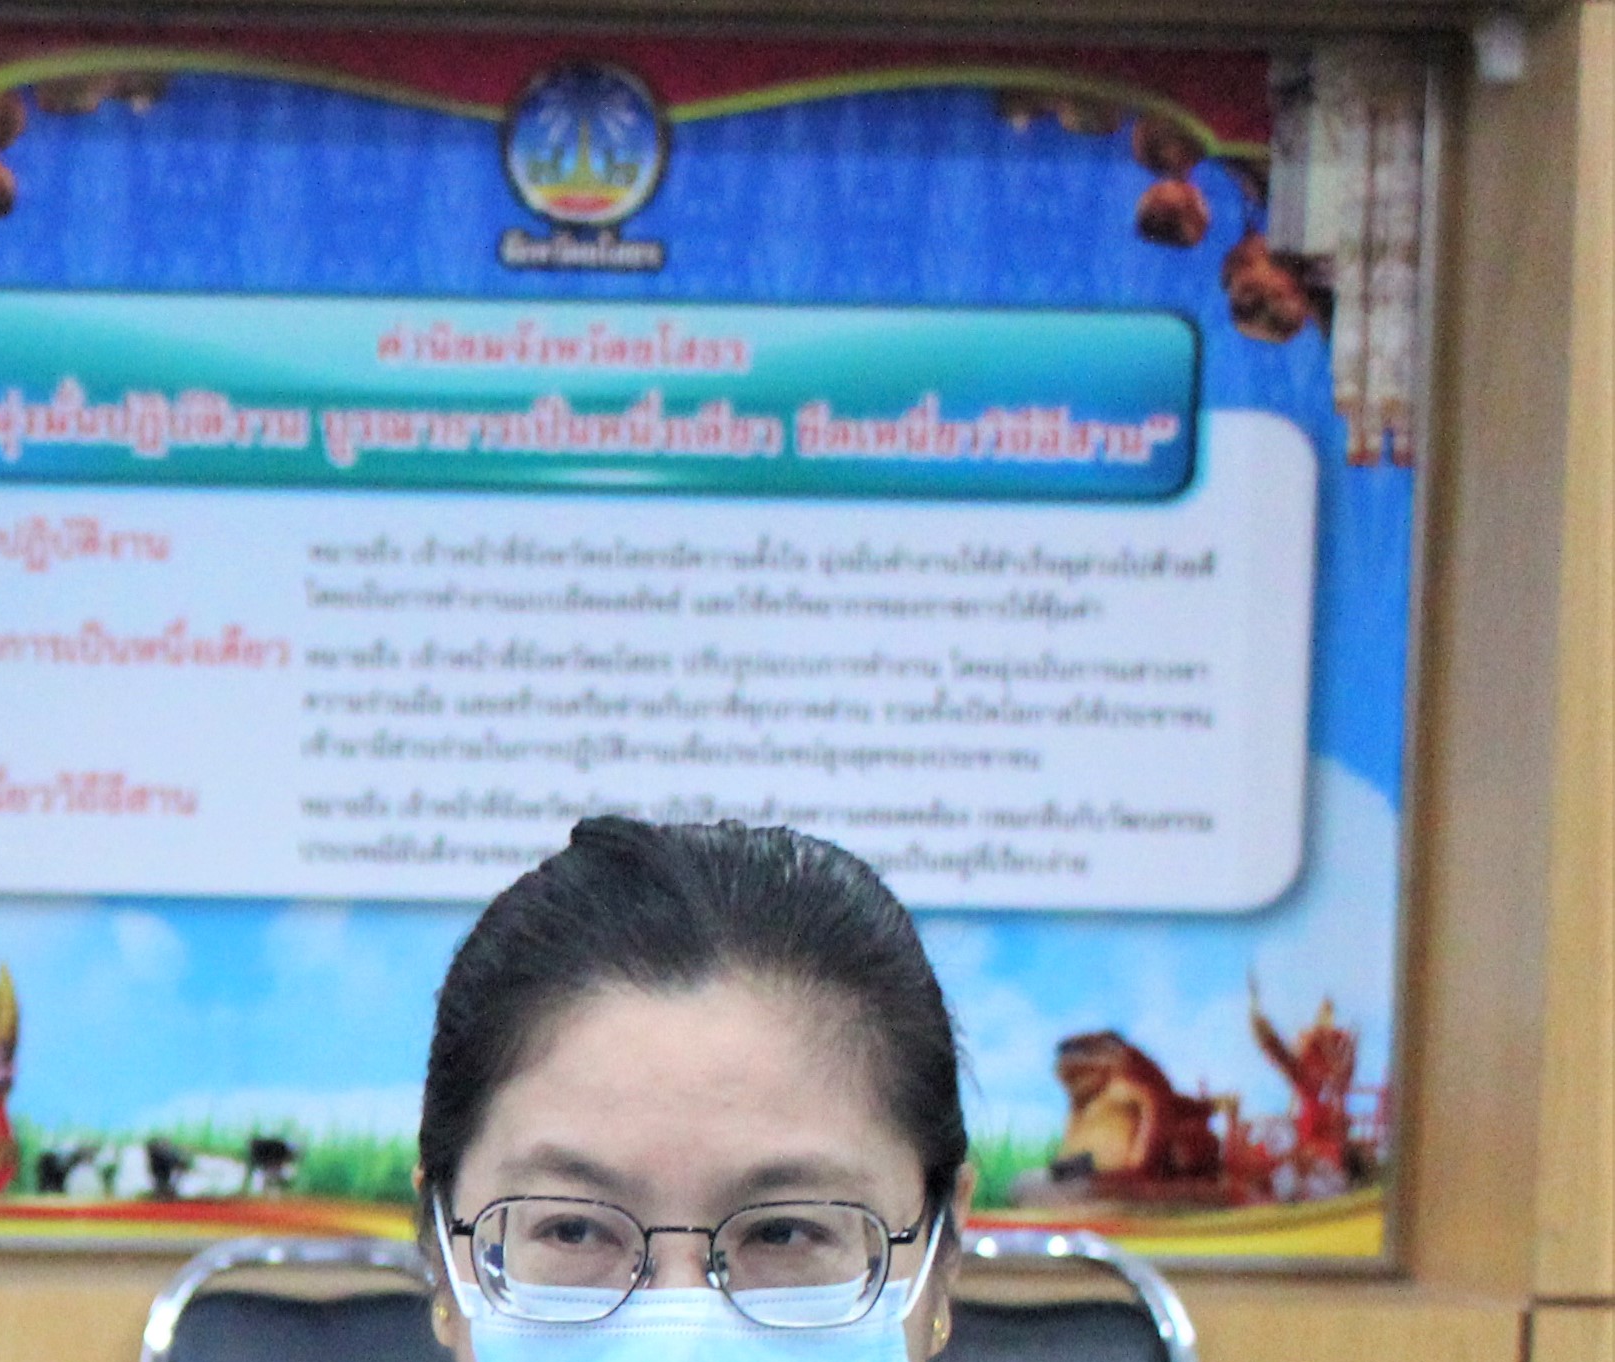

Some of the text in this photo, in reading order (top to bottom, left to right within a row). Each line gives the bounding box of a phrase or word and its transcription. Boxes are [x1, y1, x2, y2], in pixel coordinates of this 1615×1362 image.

[376, 318, 749, 373] ค่านิยมจังหวัดยโสธร
